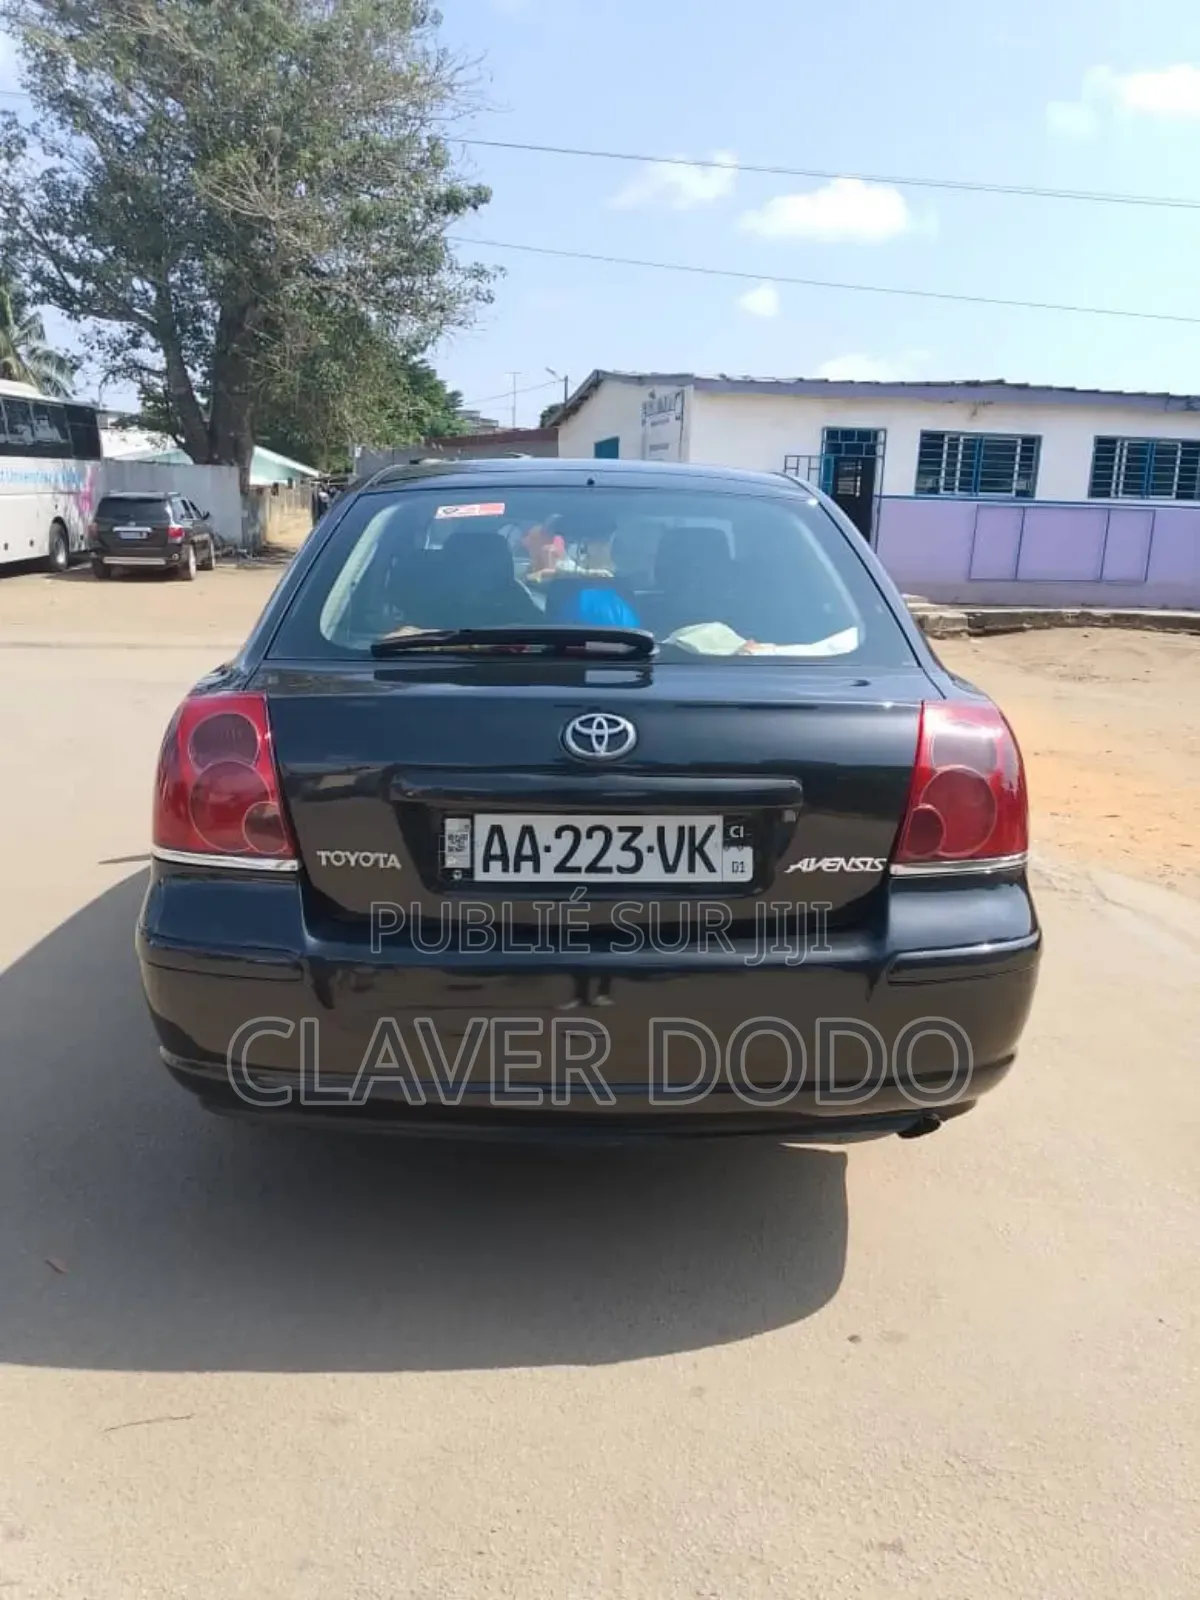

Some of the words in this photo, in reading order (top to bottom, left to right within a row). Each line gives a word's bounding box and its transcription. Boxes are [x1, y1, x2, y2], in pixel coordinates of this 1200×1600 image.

[730, 825, 744, 838] CI
[316, 850, 402, 870] TOYOTA
[784, 857, 887, 873] AVENSIS
